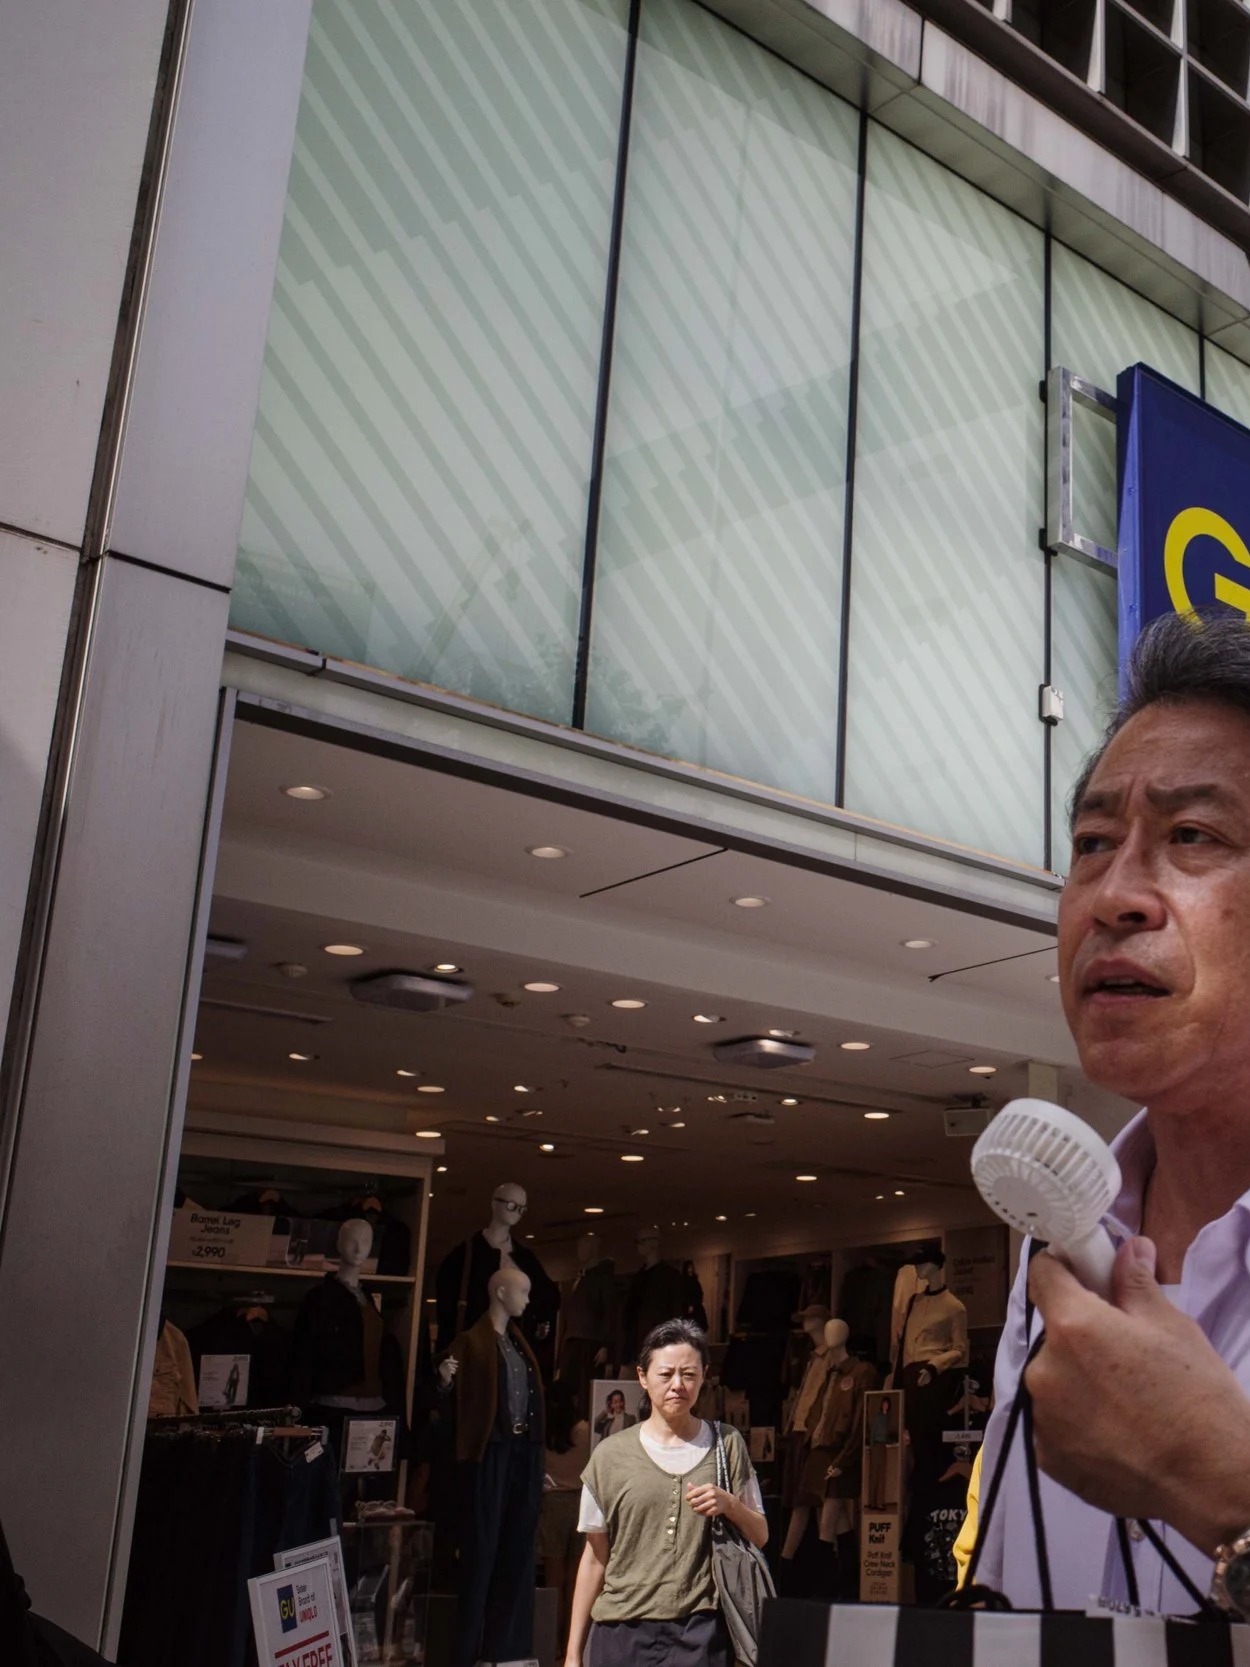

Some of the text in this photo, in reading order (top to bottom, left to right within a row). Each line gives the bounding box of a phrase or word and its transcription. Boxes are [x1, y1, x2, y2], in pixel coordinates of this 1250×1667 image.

[200, 1224, 230, 1236] Jeans
[869, 1522, 892, 1533] PUFF
[869, 1533, 886, 1544] Knit
[280, 1597, 296, 1620] GU
